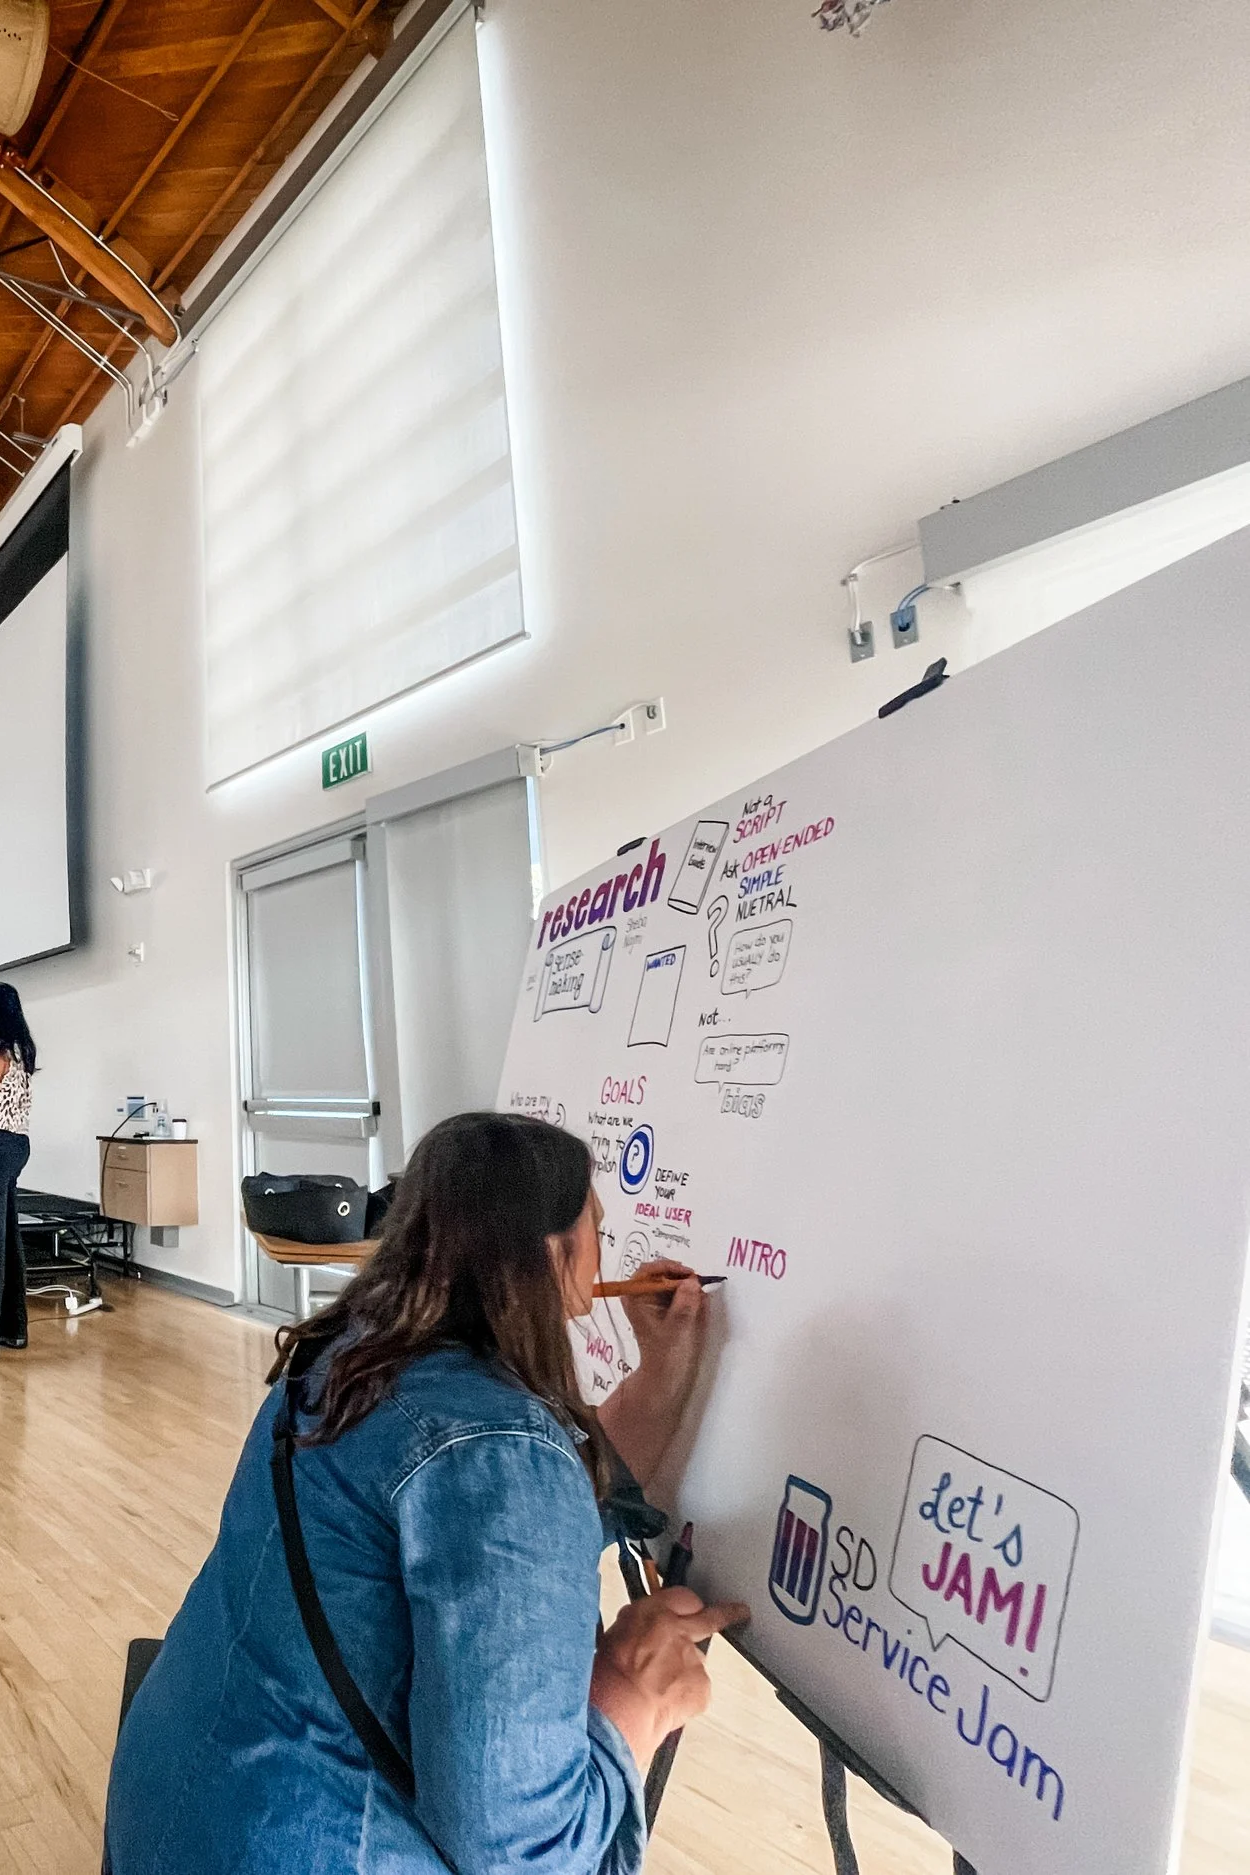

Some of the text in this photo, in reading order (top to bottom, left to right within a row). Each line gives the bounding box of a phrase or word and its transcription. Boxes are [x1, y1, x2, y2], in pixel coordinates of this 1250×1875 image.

[329, 740, 362, 783] EXIT
[733, 800, 787, 844] SCRIPT
[743, 794, 773, 816] Not a
[537, 838, 666, 950] research
[737, 864, 786, 899] SIMPLE
[735, 885, 797, 922] NUETRAL
[646, 953, 676, 971] WANTED
[549, 973, 584, 1001] making
[600, 1075, 647, 1105] GOALS
[720, 1088, 766, 1119] bias
[655, 1168, 689, 1186] DEFINE
[635, 1203, 692, 1227] IDEAL USER
[726, 1236, 786, 1280] INTRO
[586, 1334, 613, 1364] WHO
[919, 1472, 1023, 1567] Let's
[831, 1526, 877, 1590] SD
[922, 1542, 1047, 1677] JAM!
[823, 1575, 1065, 1821] Service Jam
